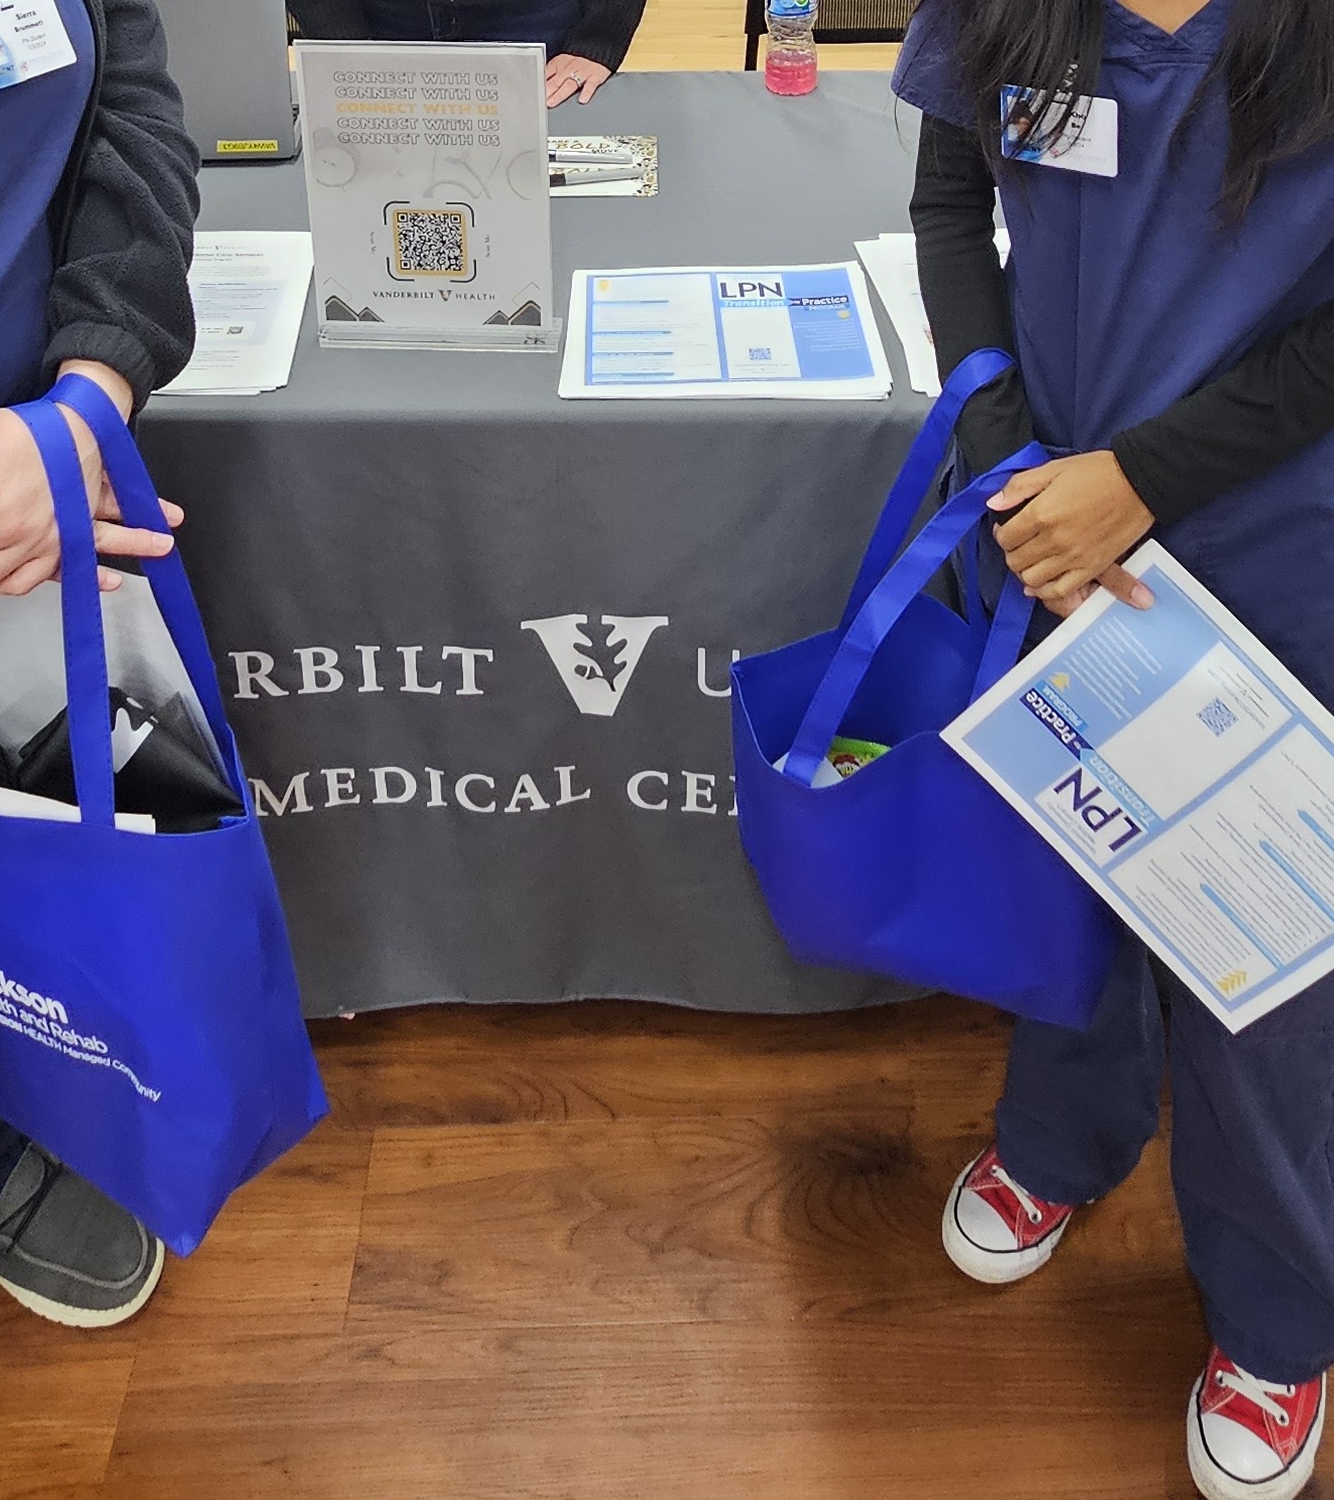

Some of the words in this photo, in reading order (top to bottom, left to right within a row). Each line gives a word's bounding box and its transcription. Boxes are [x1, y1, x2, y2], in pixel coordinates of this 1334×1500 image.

[333, 71, 415, 84] CONNECT
[421, 72, 470, 85] WITH
[475, 73, 499, 85] US
[335, 86, 417, 99] CONNECT
[421, 87, 471, 100] WITH
[476, 88, 499, 101] US
[336, 102, 416, 114] CONNECT
[423, 103, 471, 115] WITH
[477, 104, 499, 116] US
[337, 117, 418, 130] CONNECT
[422, 118, 472, 131] WITH
[478, 119, 500, 131] US
[338, 132, 419, 145] CONNECT
[424, 133, 473, 146] WITH
[478, 134, 501, 146] US
[372, 290, 435, 300] VANDERBILT
[455, 292, 496, 301] HEALTH
[720, 282, 783, 298] LPN
[723, 299, 785, 307] Transition
[802, 296, 847, 306] Practice
[228, 644, 493, 700] RBILT
[1025, 691, 1077, 744] Practice
[247, 765, 591, 817] MEDICAL
[626, 770, 738, 817] CE
[1089, 755, 1156, 824] Transition
[1053, 767, 1143, 852] LPN
[19, 1008, 50, 1034] and
[49, 1021, 109, 1054] Rehab
